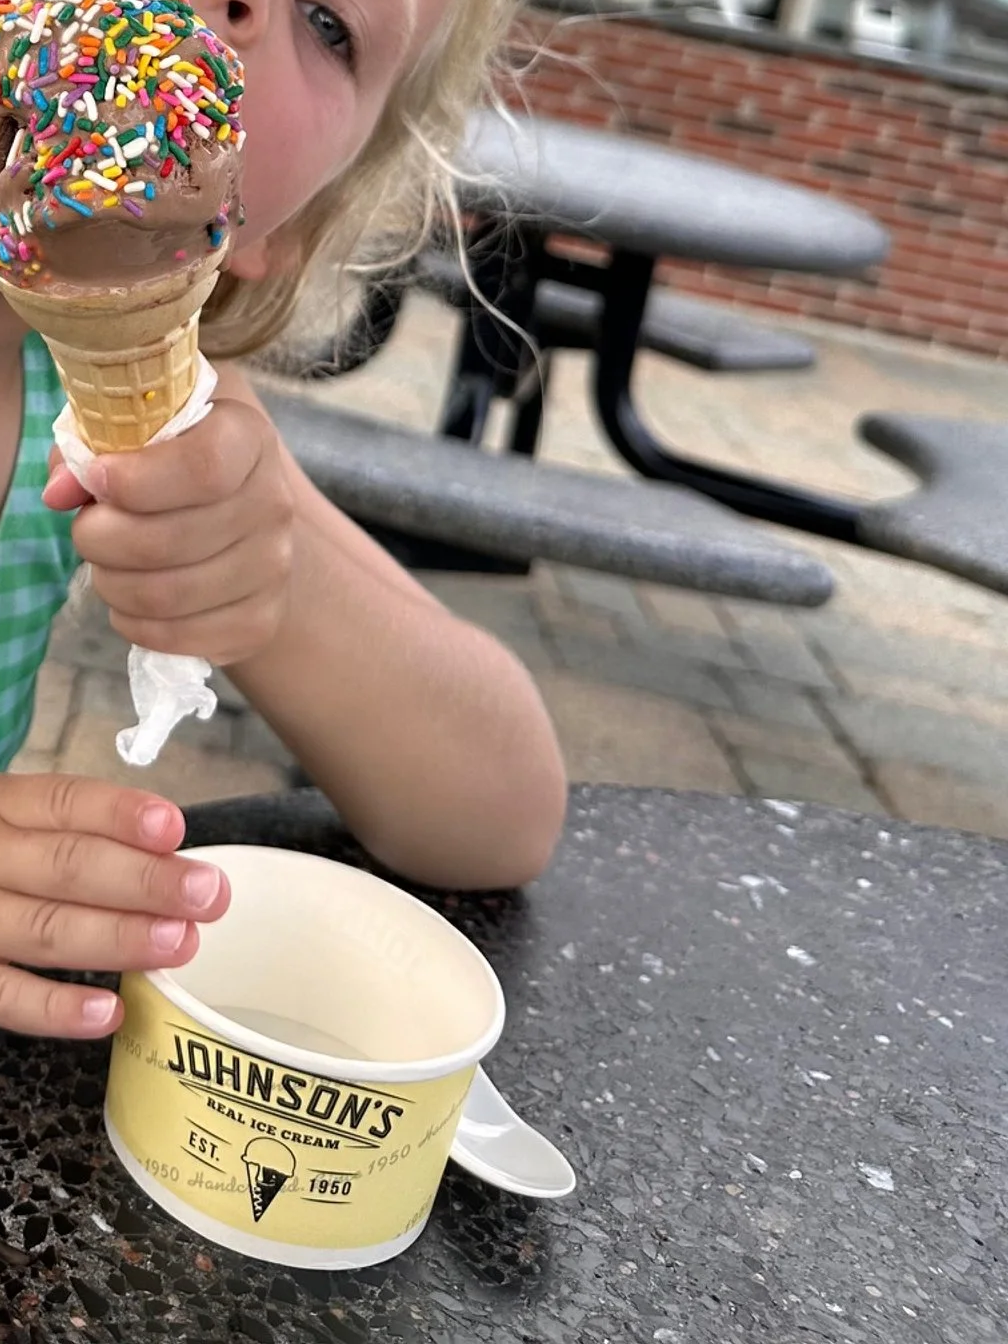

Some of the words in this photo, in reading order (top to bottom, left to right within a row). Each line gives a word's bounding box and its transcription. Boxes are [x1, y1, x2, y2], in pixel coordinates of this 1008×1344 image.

[168, 1034, 403, 1139] JOHNSON'S
[206, 1097, 246, 1125] REAL
[250, 1117, 277, 1137] ICE
[281, 1129, 340, 1151] CREAM
[144, 1158, 180, 1182] 1950
[368, 1143, 411, 1175] 1950
[188, 1130, 221, 1162] EST.
[309, 1178, 352, 1196] 1950
